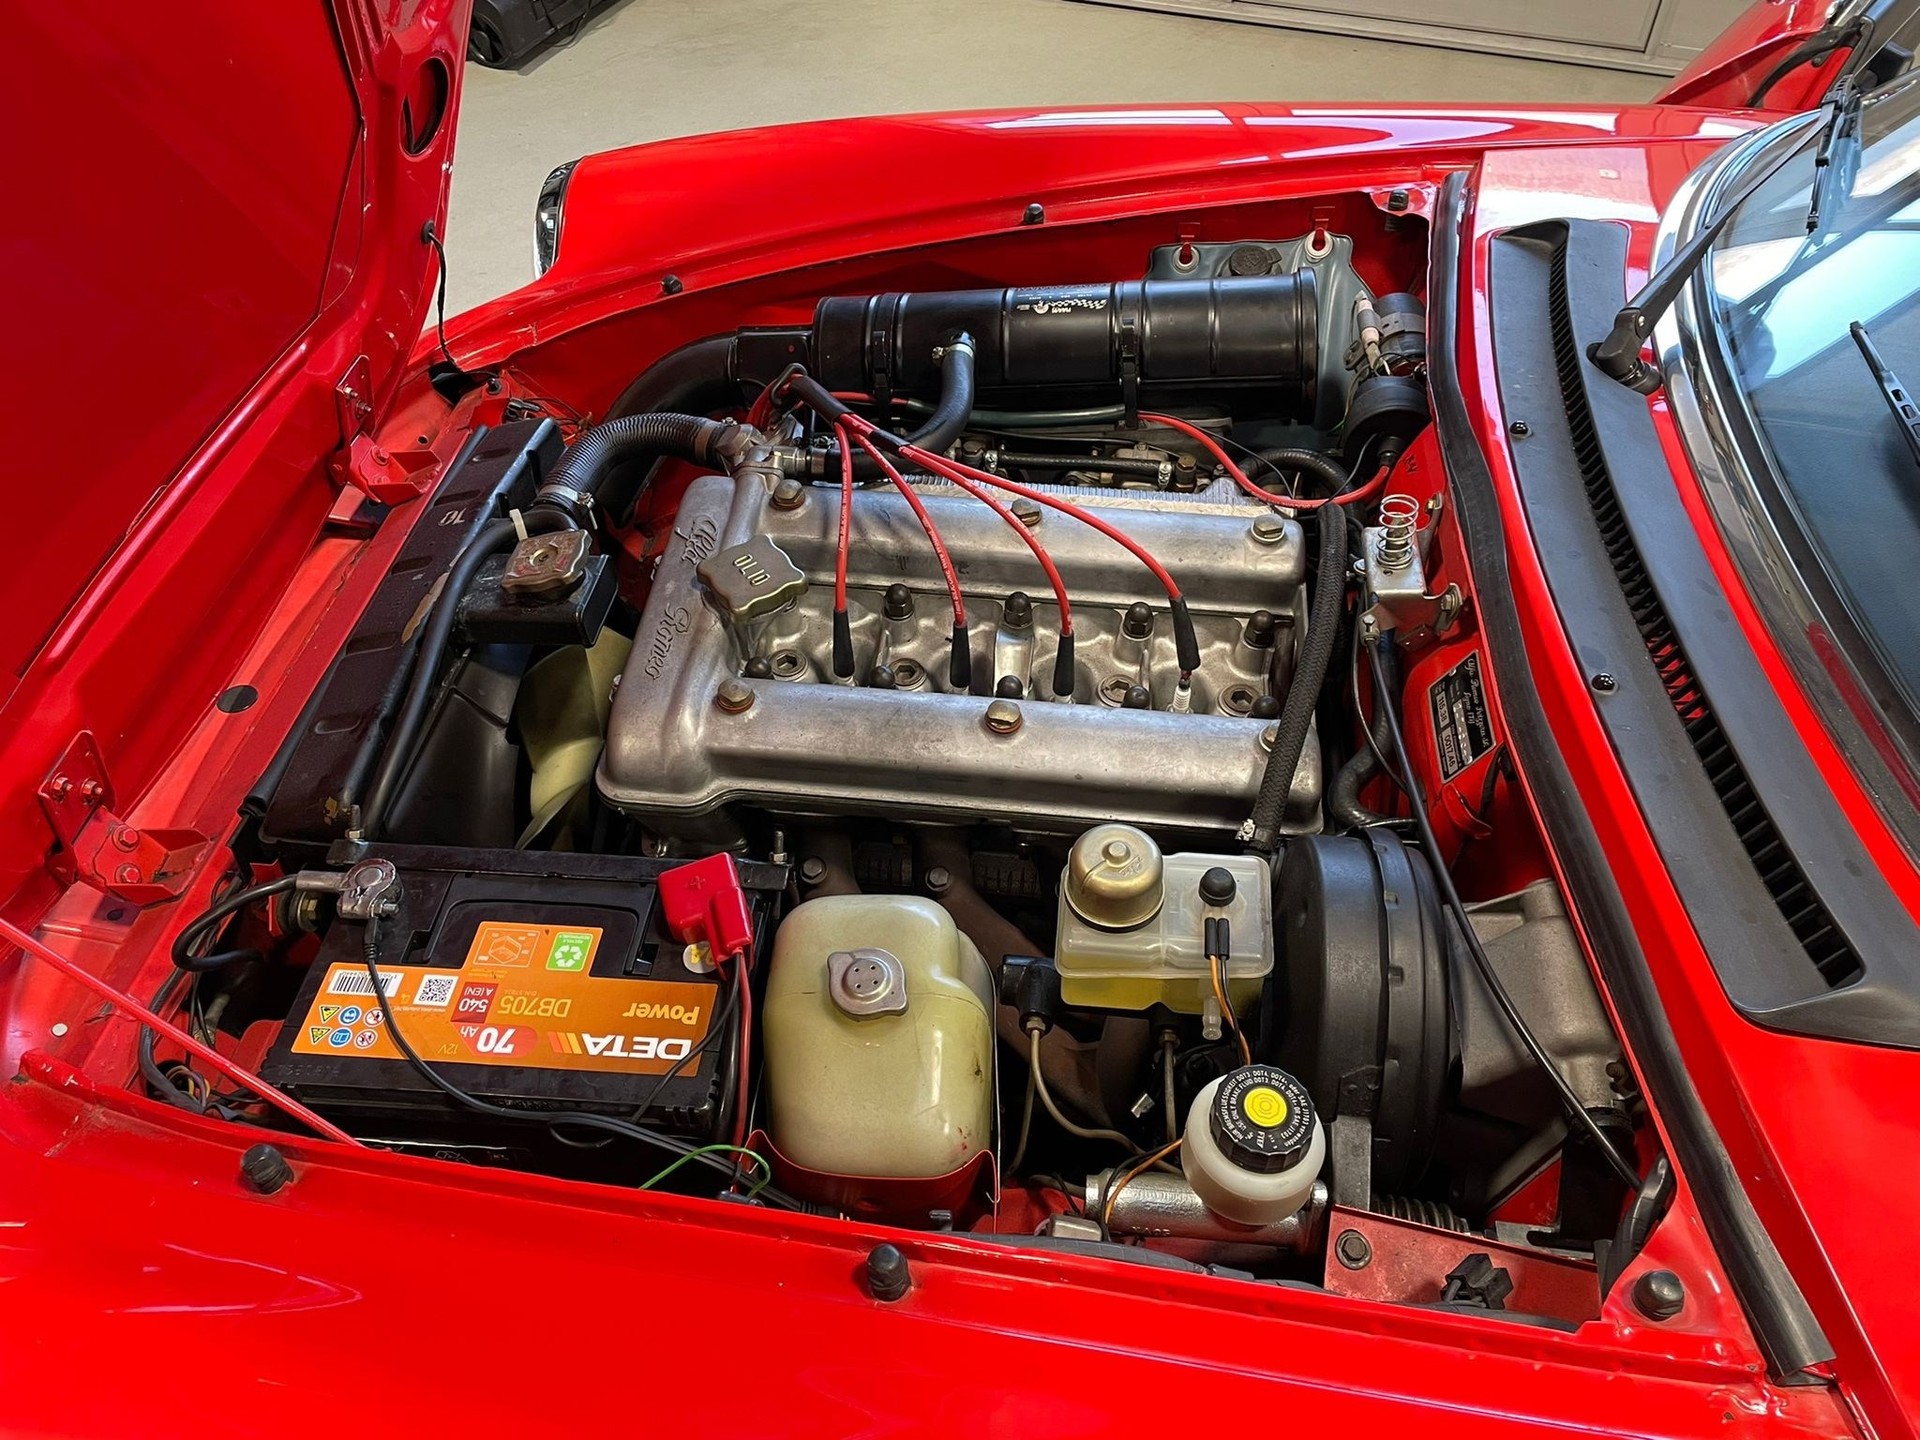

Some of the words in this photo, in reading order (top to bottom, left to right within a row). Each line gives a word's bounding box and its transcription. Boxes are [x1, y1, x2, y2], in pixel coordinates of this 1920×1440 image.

[733, 554, 771, 587] OLIO
[644, 602, 692, 681] Romeo
[1465, 658, 1474, 677] Alfa
[1471, 679, 1480, 705] Romeo
[458, 997, 489, 1013] 540
[497, 996, 573, 1018] DB705
[622, 1002, 701, 1025] Power
[459, 1025, 480, 1038] Ah
[476, 1026, 517, 1054] 70
[438, 1043, 458, 1054] 12V
[581, 1032, 693, 1061] DETA
[1239, 1079, 1254, 1090] FLUID
[1229, 1087, 1241, 1105] BRAKE
[1231, 1128, 1244, 1140] NUR
[1298, 1094, 1308, 1107] SAE
[1237, 1119, 1247, 1131] USE
